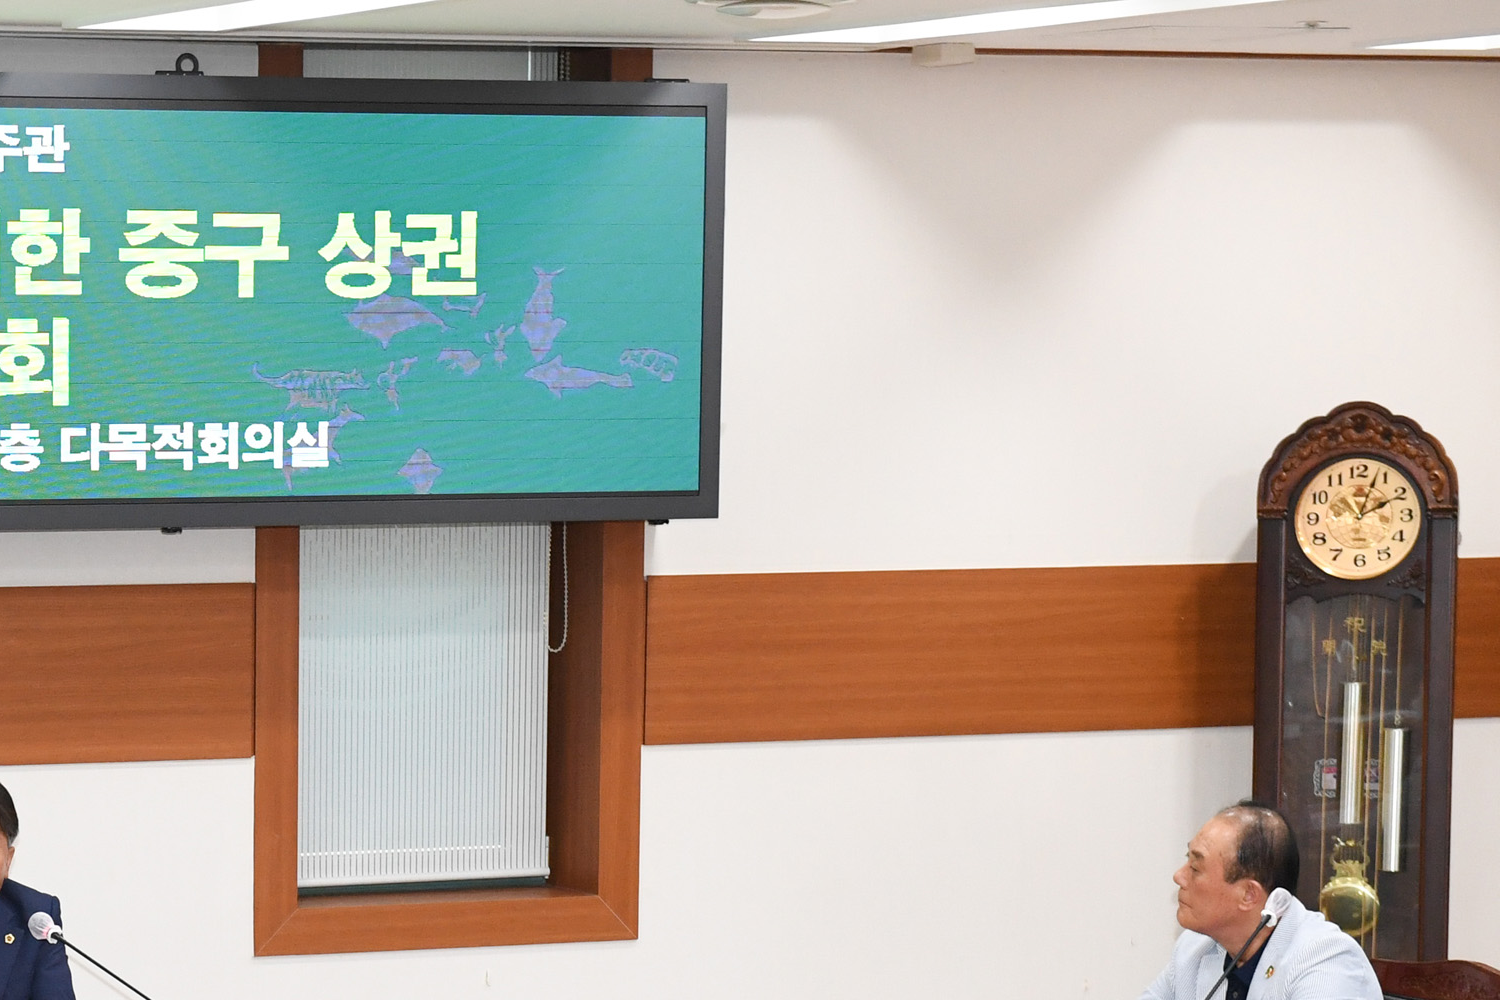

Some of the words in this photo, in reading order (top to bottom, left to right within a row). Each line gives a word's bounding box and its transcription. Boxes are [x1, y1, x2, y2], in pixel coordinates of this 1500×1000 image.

[118, 209, 290, 299] 중구
[317, 210, 480, 299] 상권
[60, 421, 331, 471] 다목적회의실
[1349, 464, 1368, 479] 12
[1328, 473, 1343, 487] 11
[1312, 490, 1329, 505] 10
[1394, 487, 1407, 501] 2
[1307, 512, 1320, 526] 9
[1400, 508, 1414, 523] 3
[1312, 532, 1327, 546] 8
[1392, 530, 1405, 543] 4
[1329, 548, 1343, 562] 7
[1377, 546, 1391, 561] 5
[1353, 554, 1367, 568] 6
